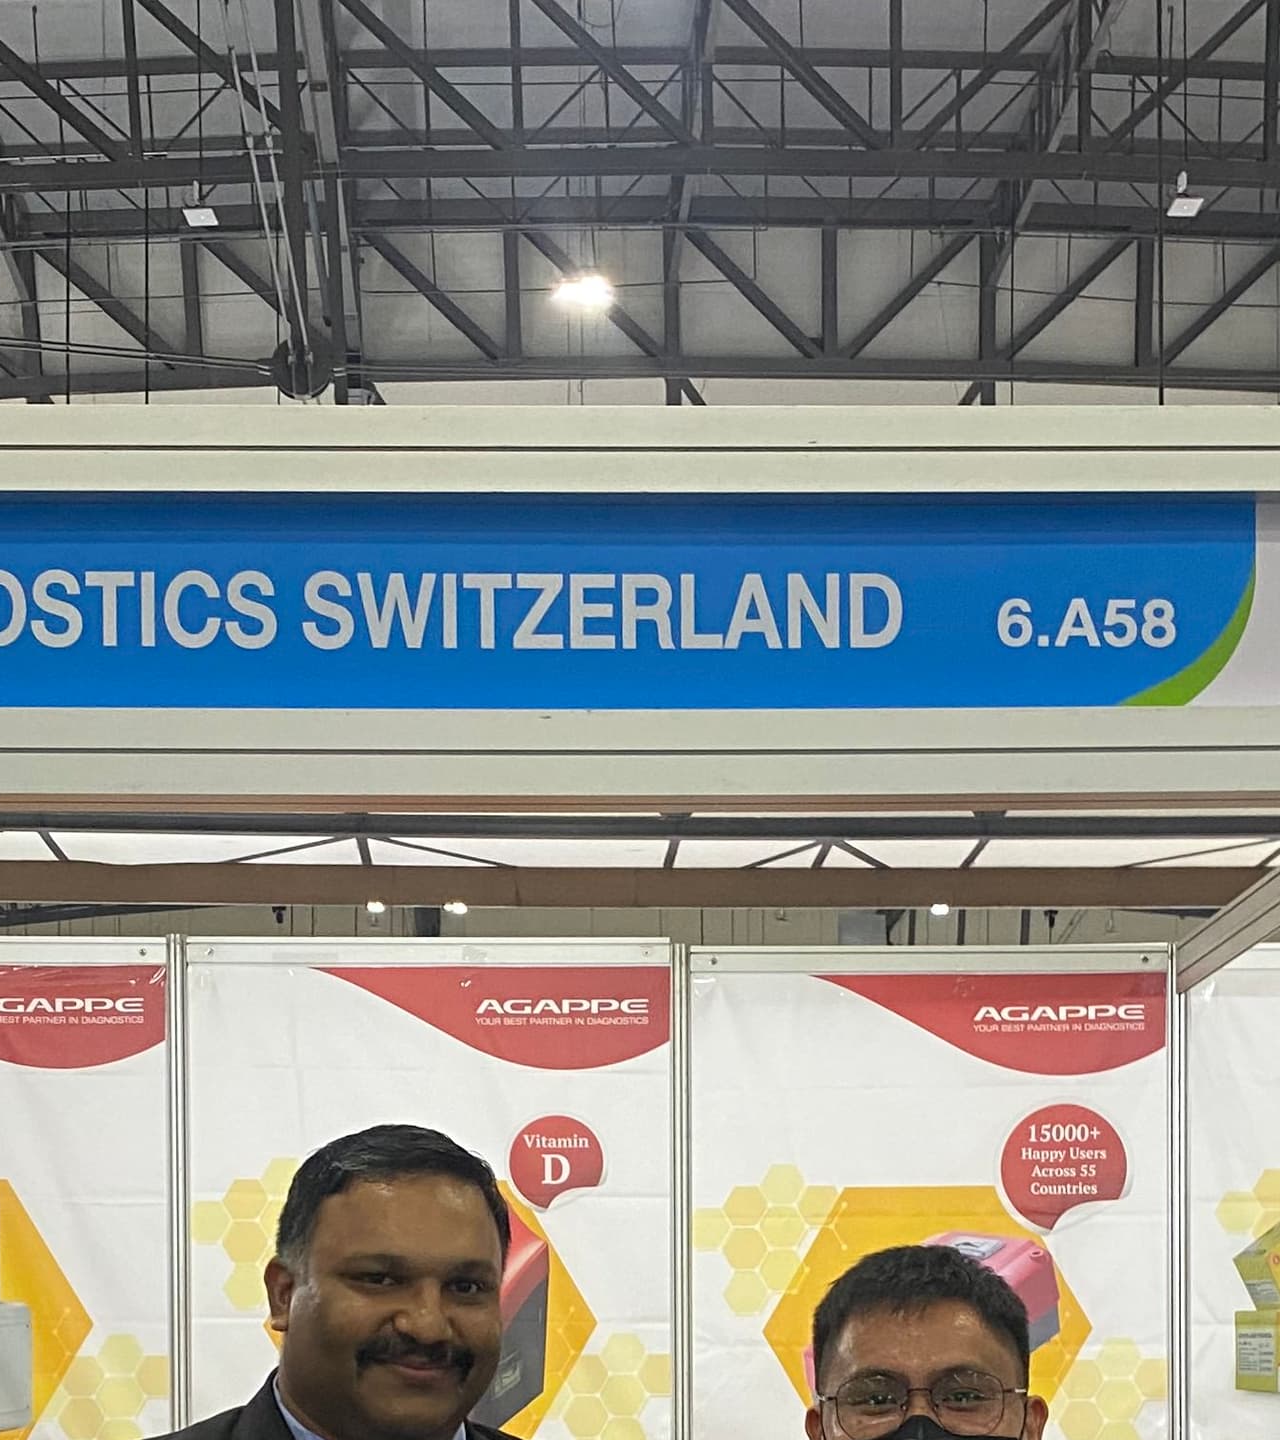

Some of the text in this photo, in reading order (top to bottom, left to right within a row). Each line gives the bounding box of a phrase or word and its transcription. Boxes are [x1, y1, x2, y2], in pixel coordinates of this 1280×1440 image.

[302, 571, 903, 651] SWITZERLAND
[996, 597, 1178, 648] 6.A58
[476, 998, 649, 1014] AGAPPE
[973, 1004, 1145, 1021] AGAPPE
[22, 1016, 67, 1024] PARTNER
[69, 1016, 79, 1024] IN
[81, 1016, 145, 1024] DIAGNOSTICS
[475, 1016, 649, 1026] YOUR BEST PARTNER IN DIAGNOSTICS
[973, 1023, 1145, 1033] YOUR BEST PARTNER IN DIAGNOSTICS
[1029, 1123, 1101, 1143] 15000+
[523, 1133, 590, 1149] Vitamin
[1021, 1147, 1107, 1162] Happy Users
[541, 1153, 571, 1185] D
[1031, 1164, 1097, 1177] Across 55
[1030, 1182, 1098, 1195] Countries
